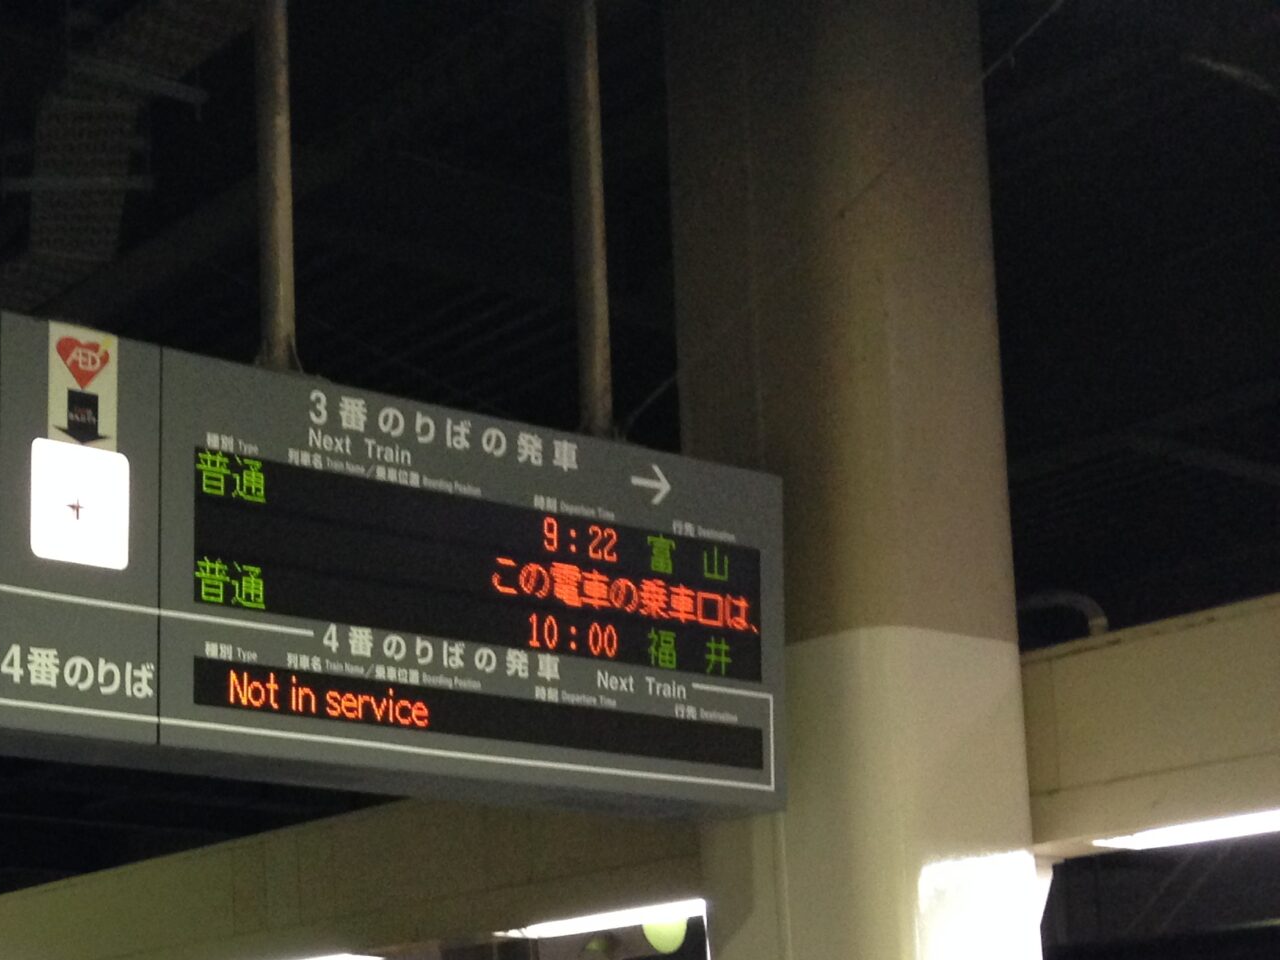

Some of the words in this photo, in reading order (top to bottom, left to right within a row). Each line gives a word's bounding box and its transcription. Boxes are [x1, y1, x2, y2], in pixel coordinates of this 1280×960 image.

[65, 346, 101, 371] AED
[308, 388, 579, 472] 3番のりばの発車
[308, 427, 352, 456] Next
[364, 437, 412, 466] Train
[195, 450, 267, 504] 普通
[543, 516, 618, 562] 9:22
[195, 555, 266, 609] 普通
[323, 622, 561, 681] 4番のりばの発車
[528, 613, 618, 658] 10:00
[0, 643, 156, 699] 4番のりば
[596, 669, 635, 694] Next
[646, 676, 687, 700] Train
[229, 669, 280, 710] Not
[291, 674, 316, 714] in
[325, 688, 430, 728] service
